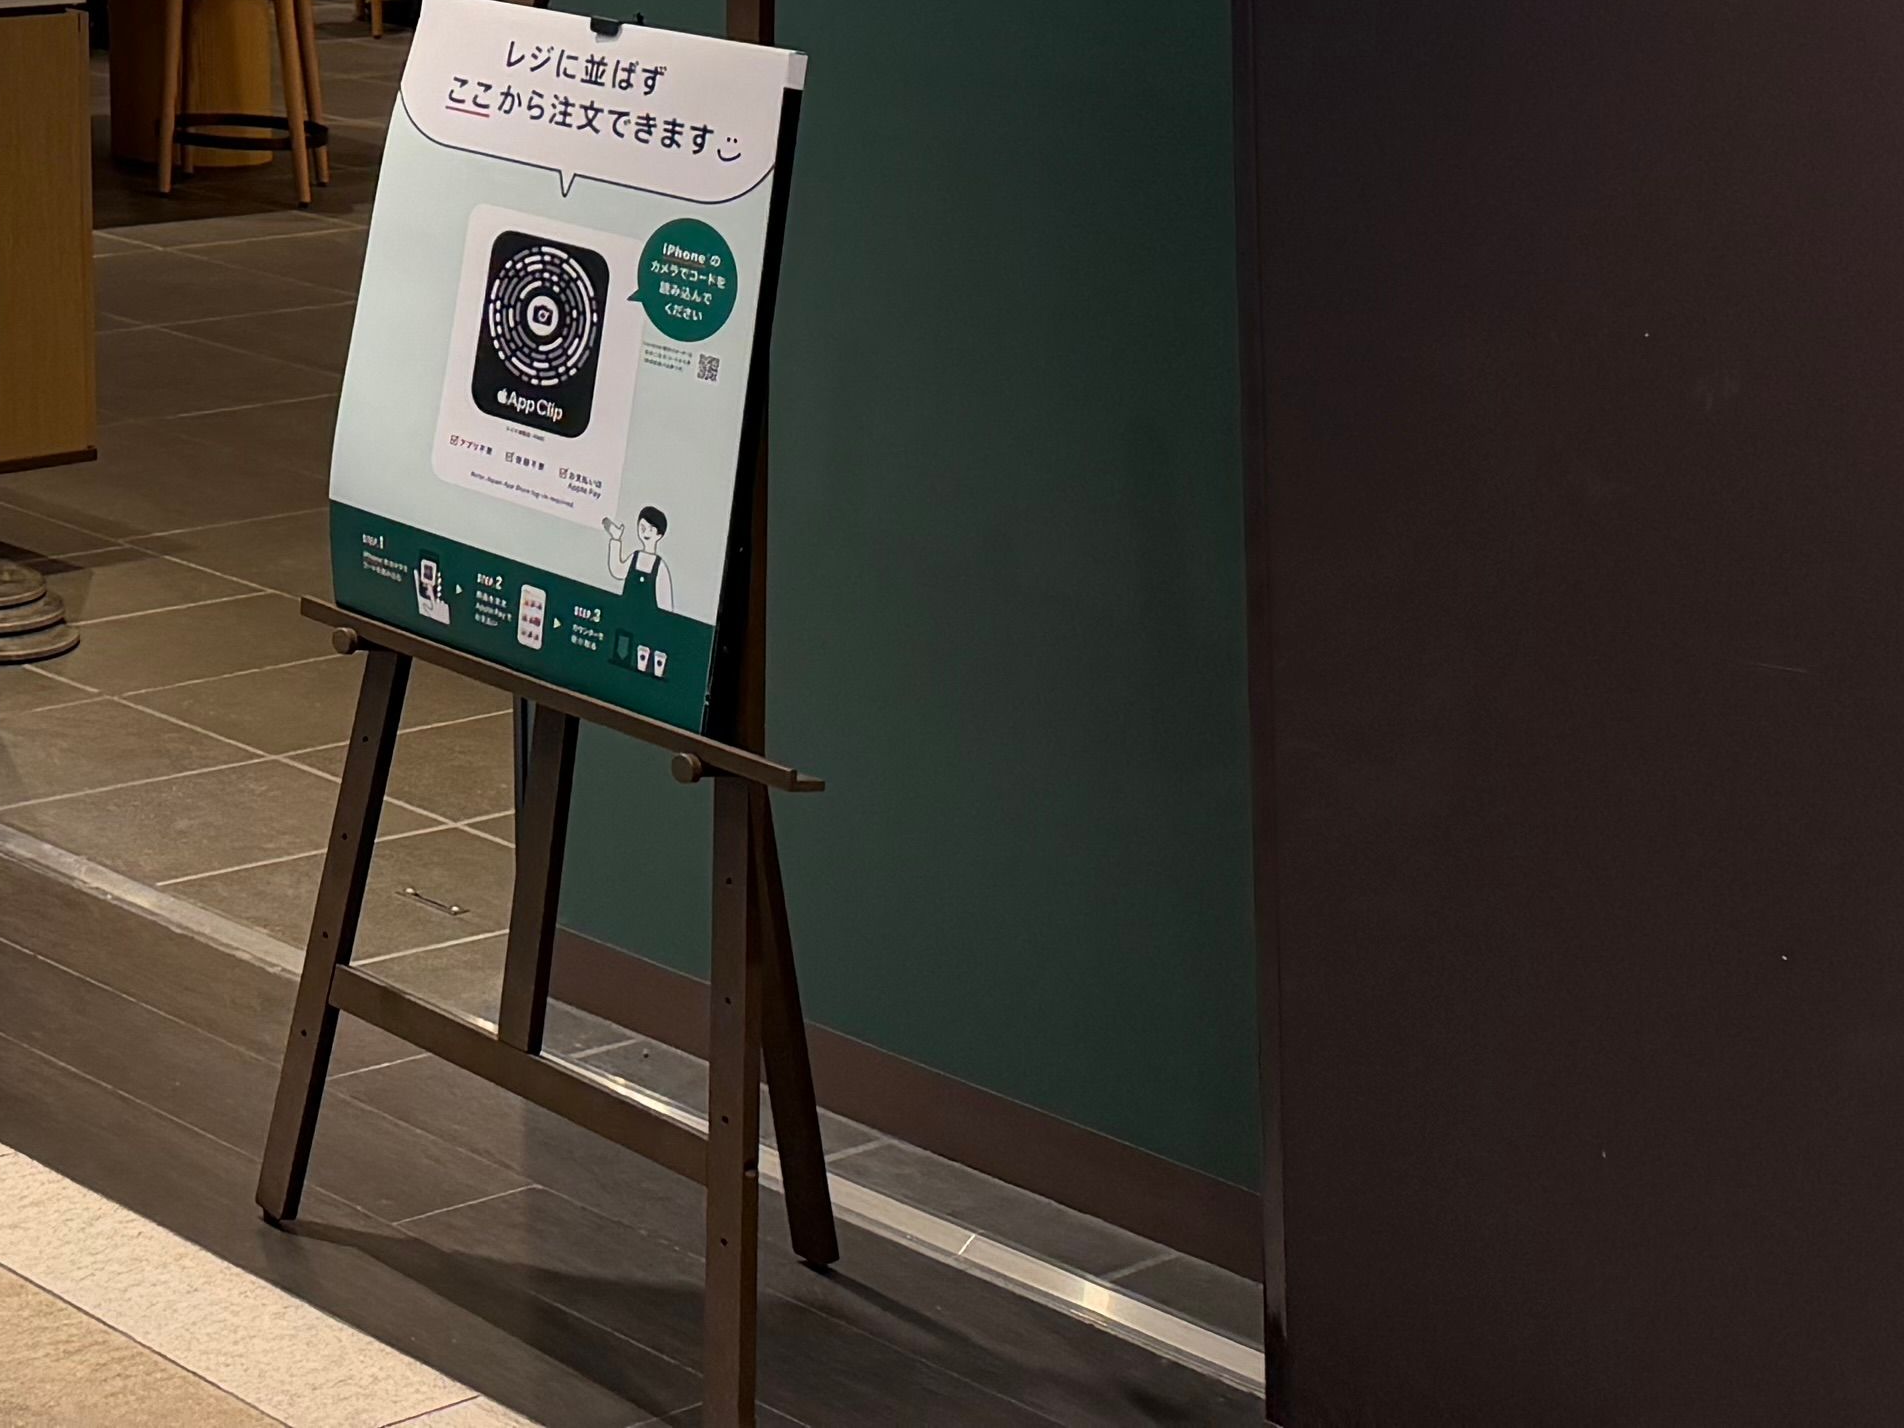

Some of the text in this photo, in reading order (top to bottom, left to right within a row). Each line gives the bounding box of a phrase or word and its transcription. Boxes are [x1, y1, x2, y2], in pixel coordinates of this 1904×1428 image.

[505, 40, 668, 96] レジに並ばず
[447, 75, 715, 155] ここから注文できます
[650, 259, 727, 290] カメラでコードを
[658, 280, 713, 305] 読み込んで
[664, 301, 704, 322] ください
[507, 391, 564, 423] App Clip
